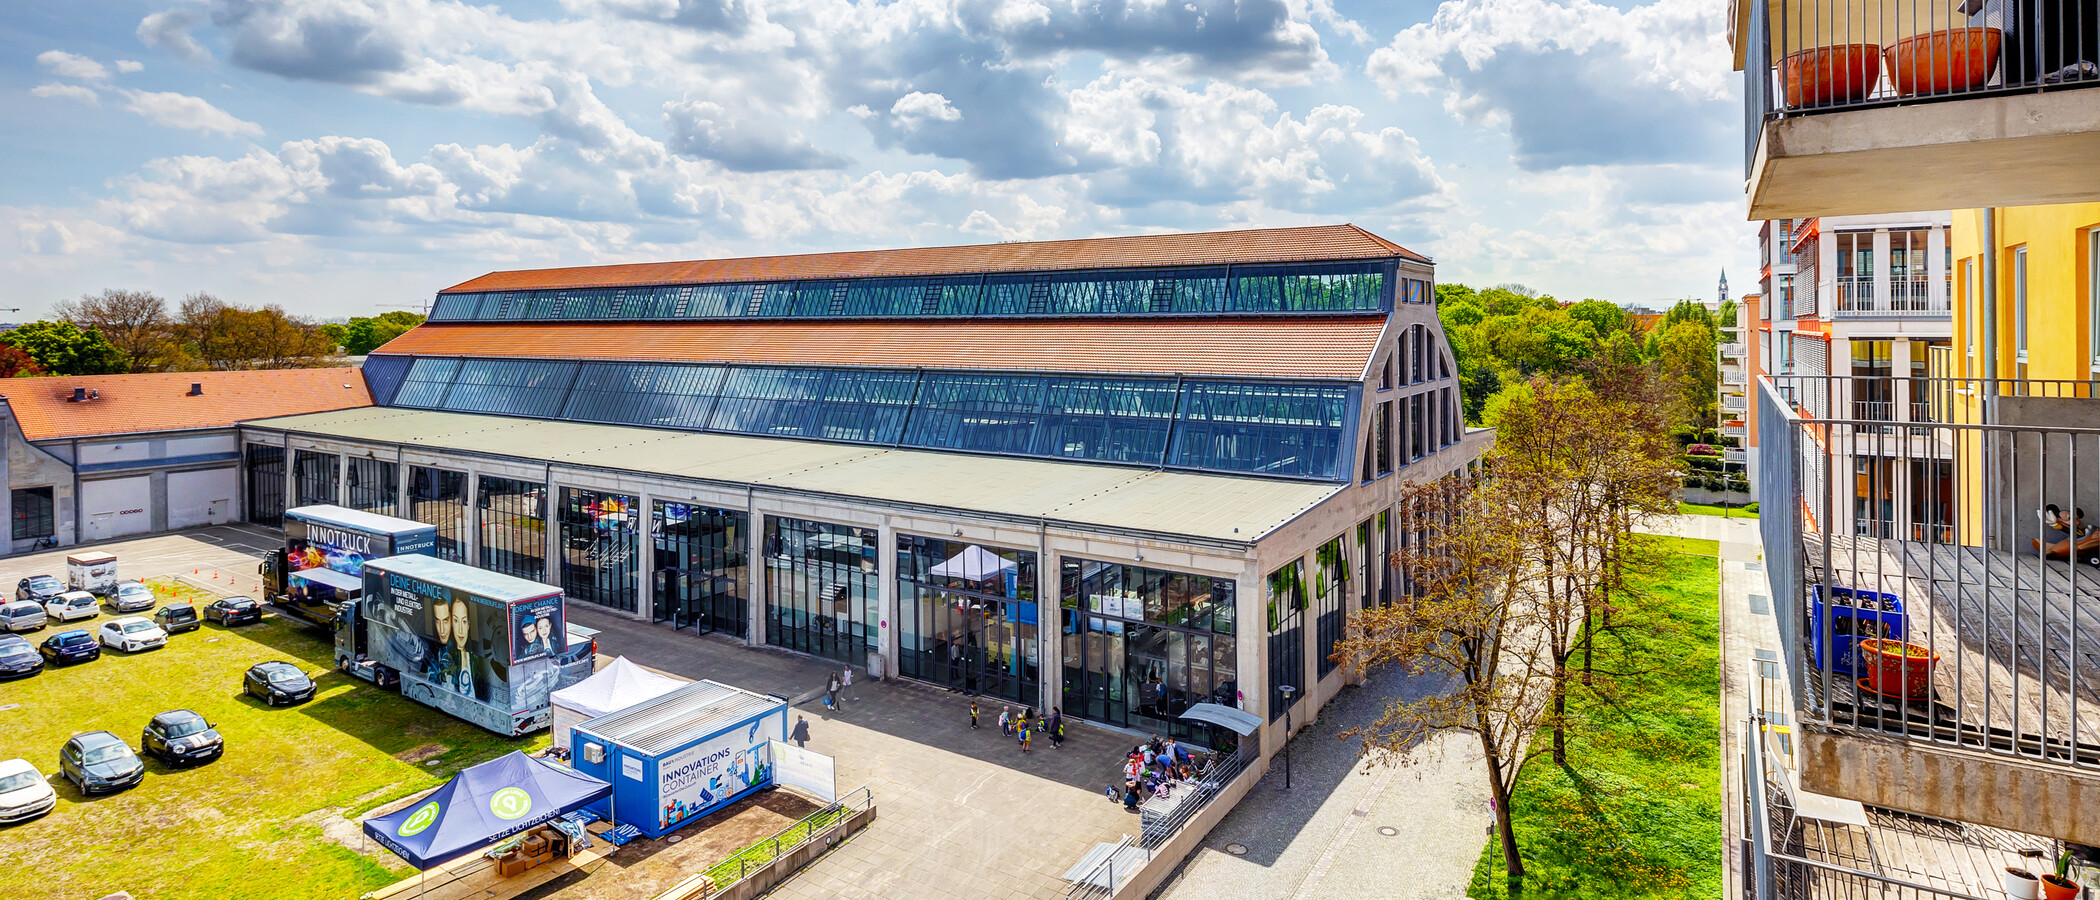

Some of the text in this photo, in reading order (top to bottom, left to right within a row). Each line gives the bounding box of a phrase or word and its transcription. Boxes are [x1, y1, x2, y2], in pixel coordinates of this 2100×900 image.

[306, 524, 371, 555] INNOTRUCK
[397, 541, 434, 552] INNOTRUCK
[390, 574, 411, 592] DEINE
[411, 579, 442, 600] CHANCE
[515, 597, 559, 613] DEINE CHANCE
[662, 747, 731, 784] INNOVATIONS
[662, 762, 719, 793] CONTAINER
[488, 828, 511, 843] SETZE
